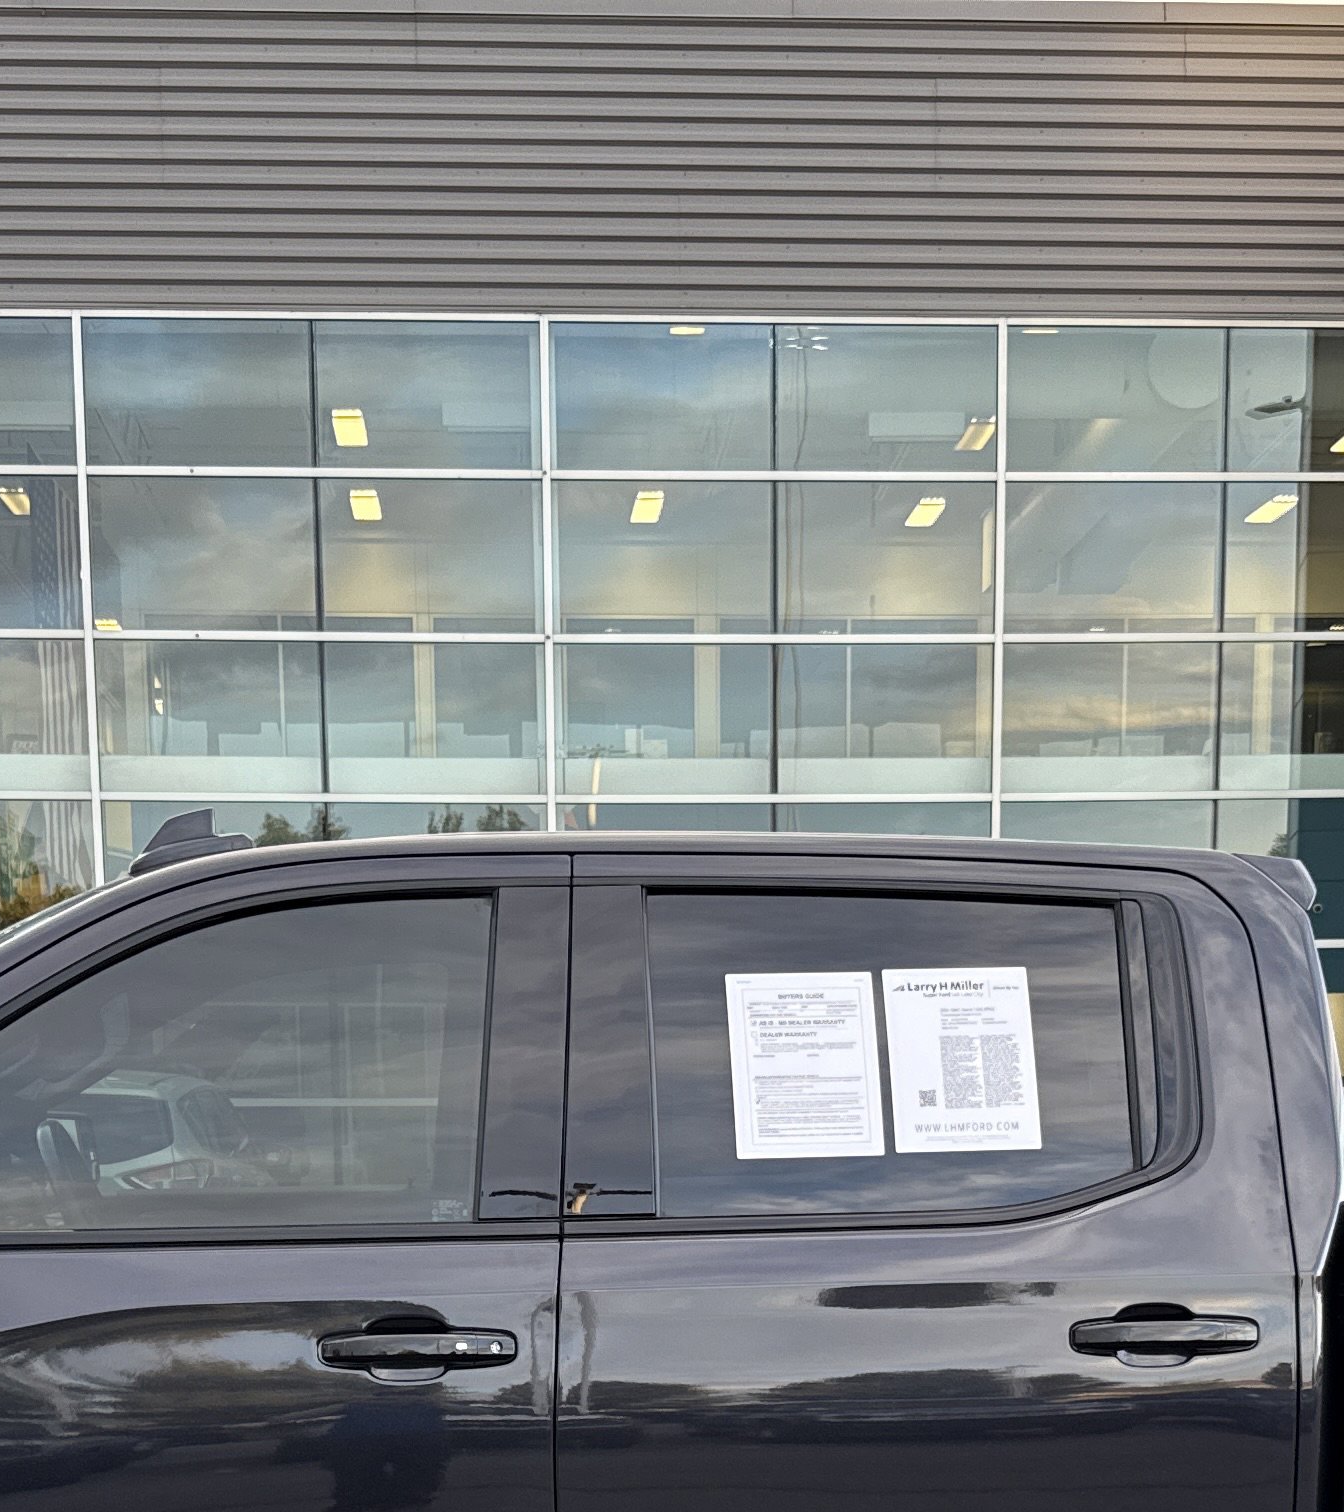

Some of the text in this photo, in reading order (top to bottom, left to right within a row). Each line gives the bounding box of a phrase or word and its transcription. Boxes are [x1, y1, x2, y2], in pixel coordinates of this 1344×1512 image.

[907, 980, 984, 993] Larry H Miller
